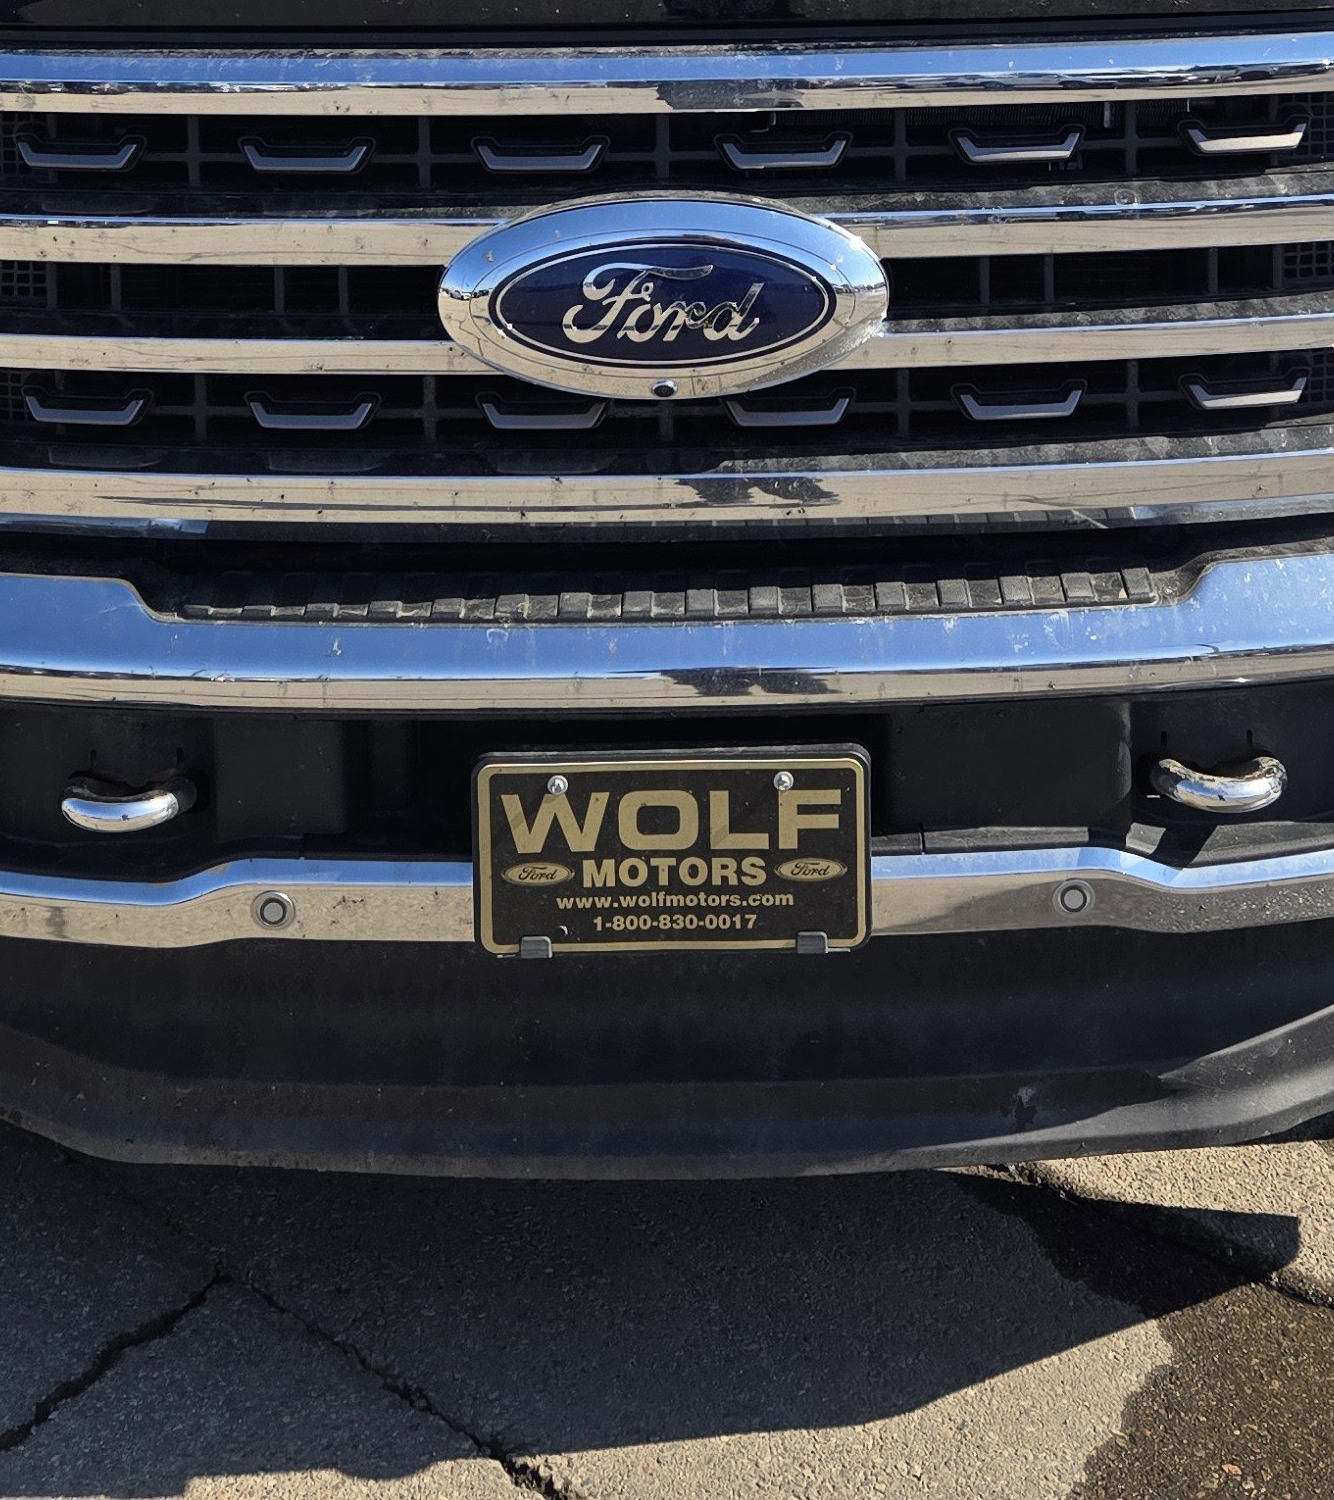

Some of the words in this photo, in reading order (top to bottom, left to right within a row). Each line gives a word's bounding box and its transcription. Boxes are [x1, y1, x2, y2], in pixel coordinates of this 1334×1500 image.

[561, 261, 765, 344] Ford
[500, 788, 842, 854] WOLF
[582, 856, 768, 889] MOTORS
[556, 891, 795, 909] www.wolfmotors.com
[593, 914, 758, 932] 1-800-830-0017
